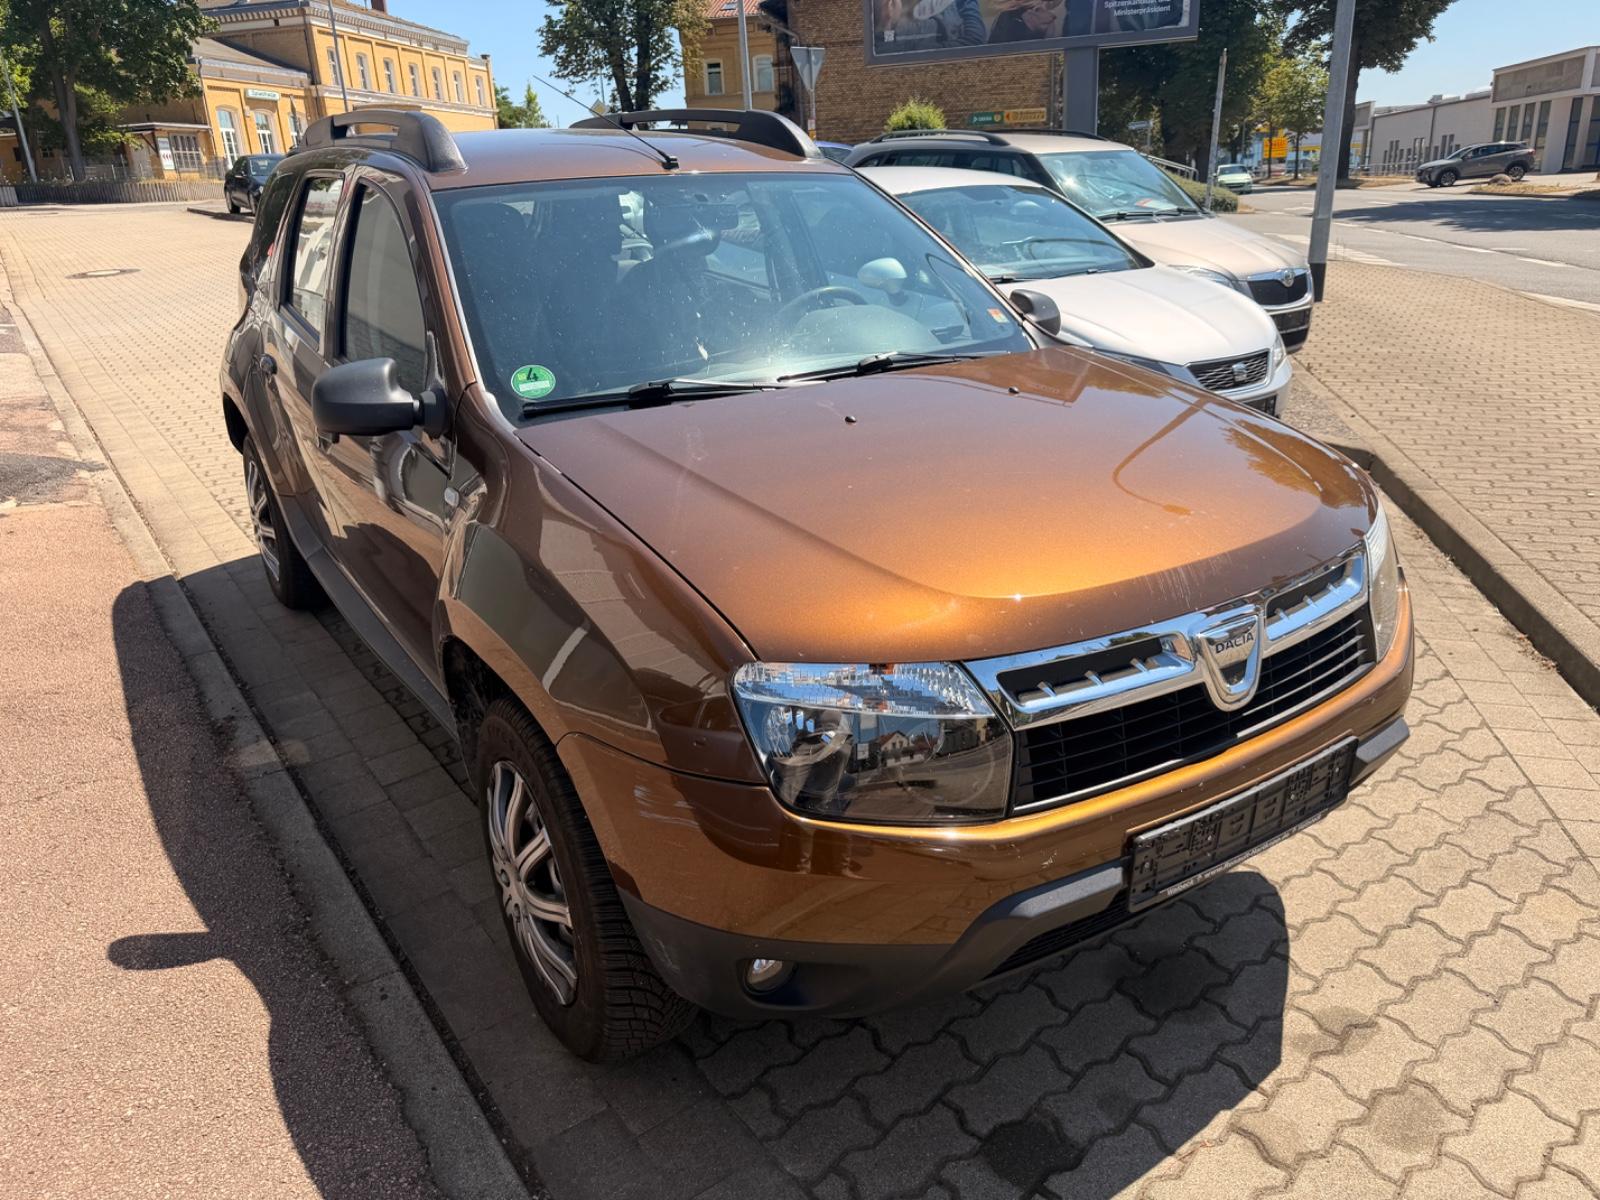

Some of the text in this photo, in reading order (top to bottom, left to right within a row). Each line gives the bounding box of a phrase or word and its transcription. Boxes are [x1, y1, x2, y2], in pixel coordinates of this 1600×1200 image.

[1113, 5, 1171, 16] Ministerpräsident
[526, 367, 539, 382] 4
[1215, 632, 1254, 654] DACIA
